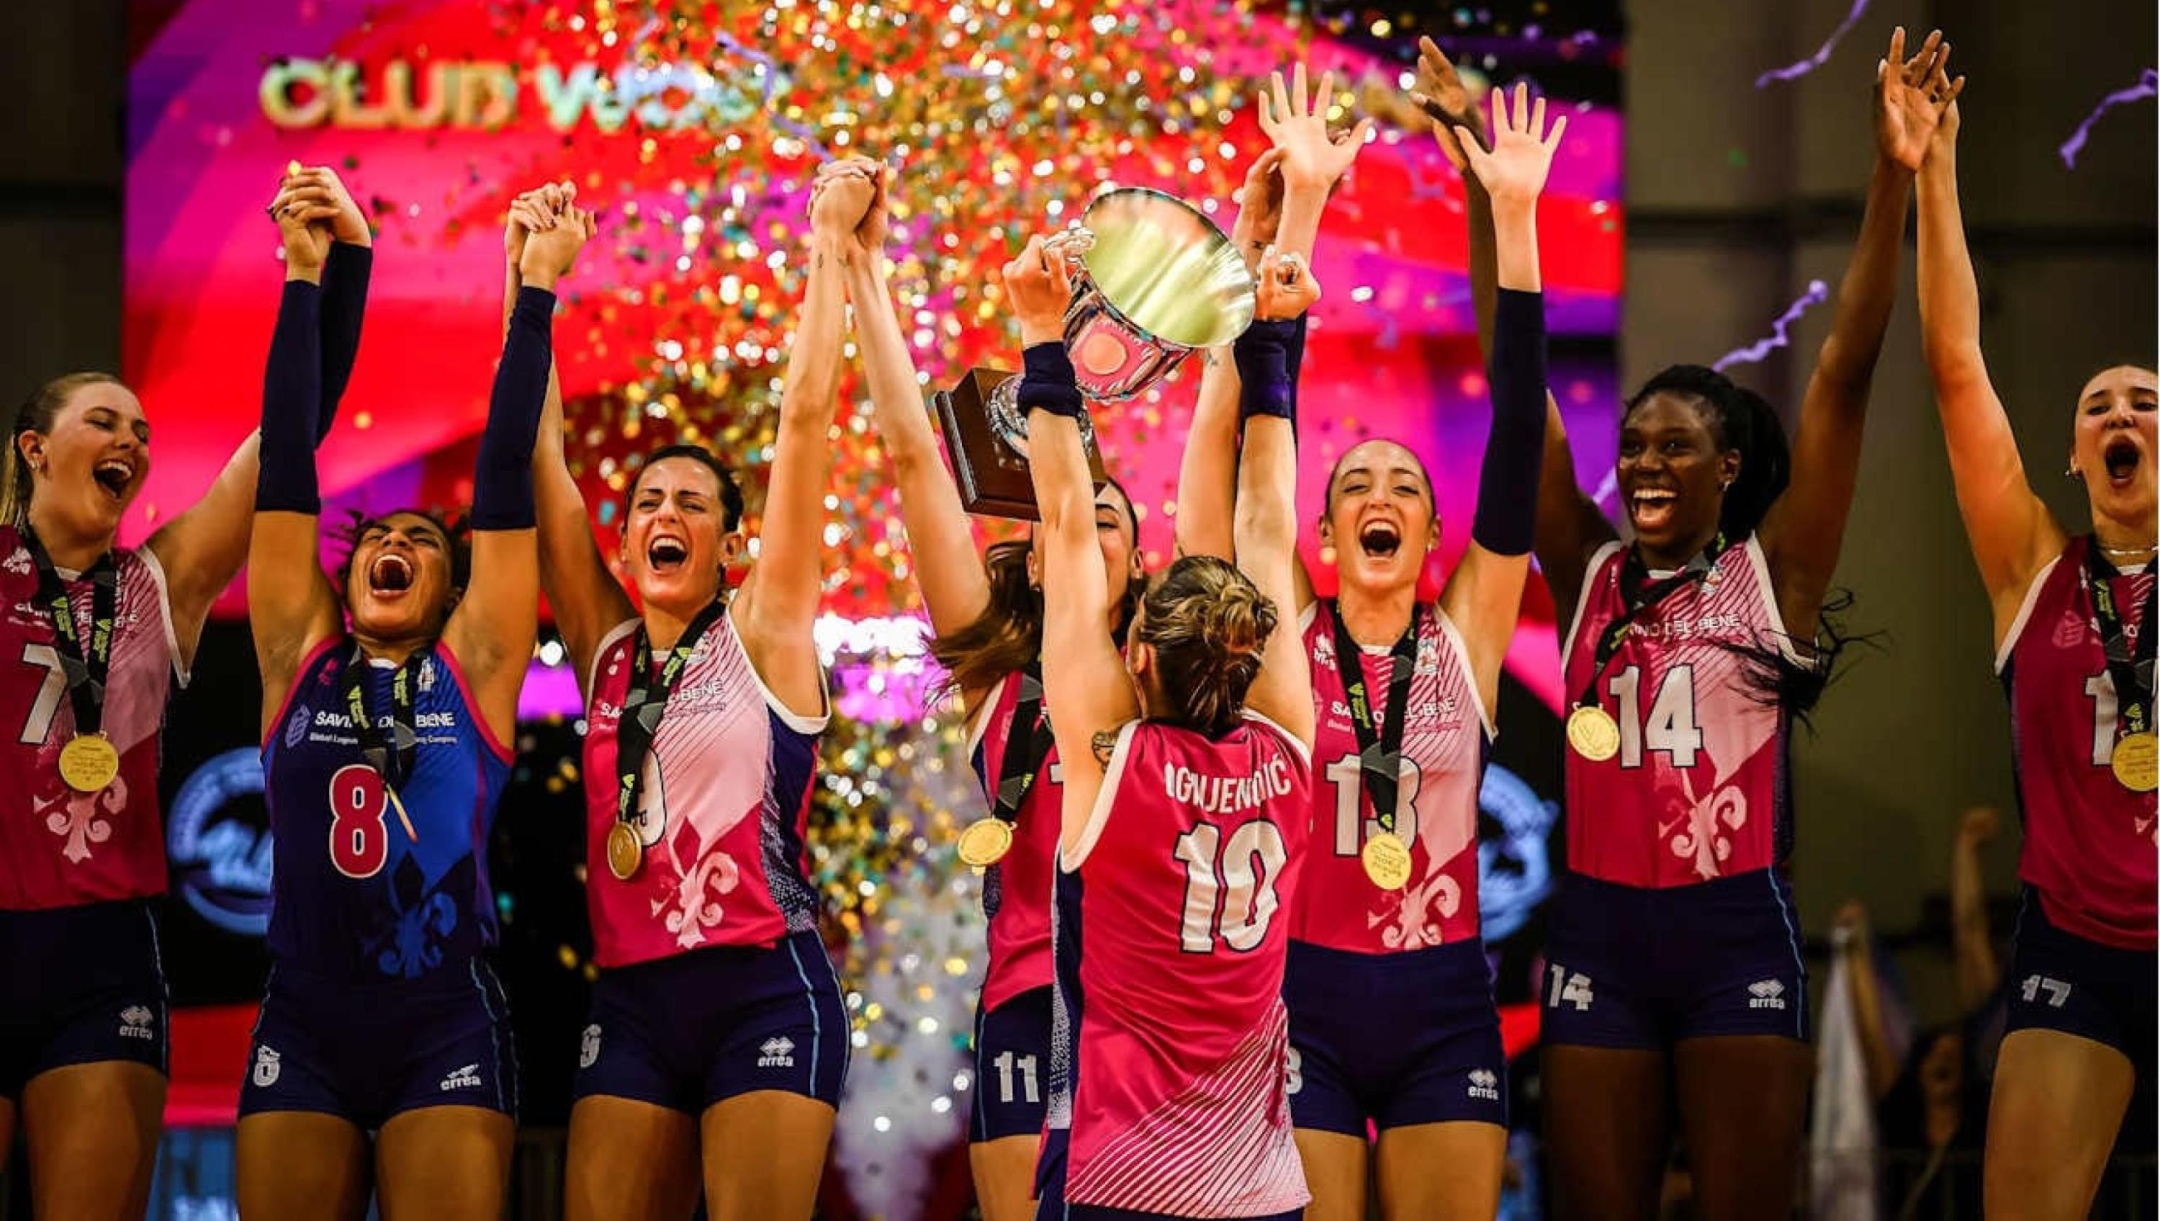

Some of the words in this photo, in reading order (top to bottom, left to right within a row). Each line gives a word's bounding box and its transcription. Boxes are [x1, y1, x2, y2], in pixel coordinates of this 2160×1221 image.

[20, 643, 66, 745] 7
[415, 712, 456, 728] BENE
[1609, 662, 1702, 771] 14
[328, 763, 389, 880] 8
[1324, 753, 1422, 859] 13
[1173, 819, 1288, 954] 10
[1549, 963, 1594, 1011] 14
[2021, 974, 2071, 1007] 17
[993, 1050, 1040, 1103] 11
